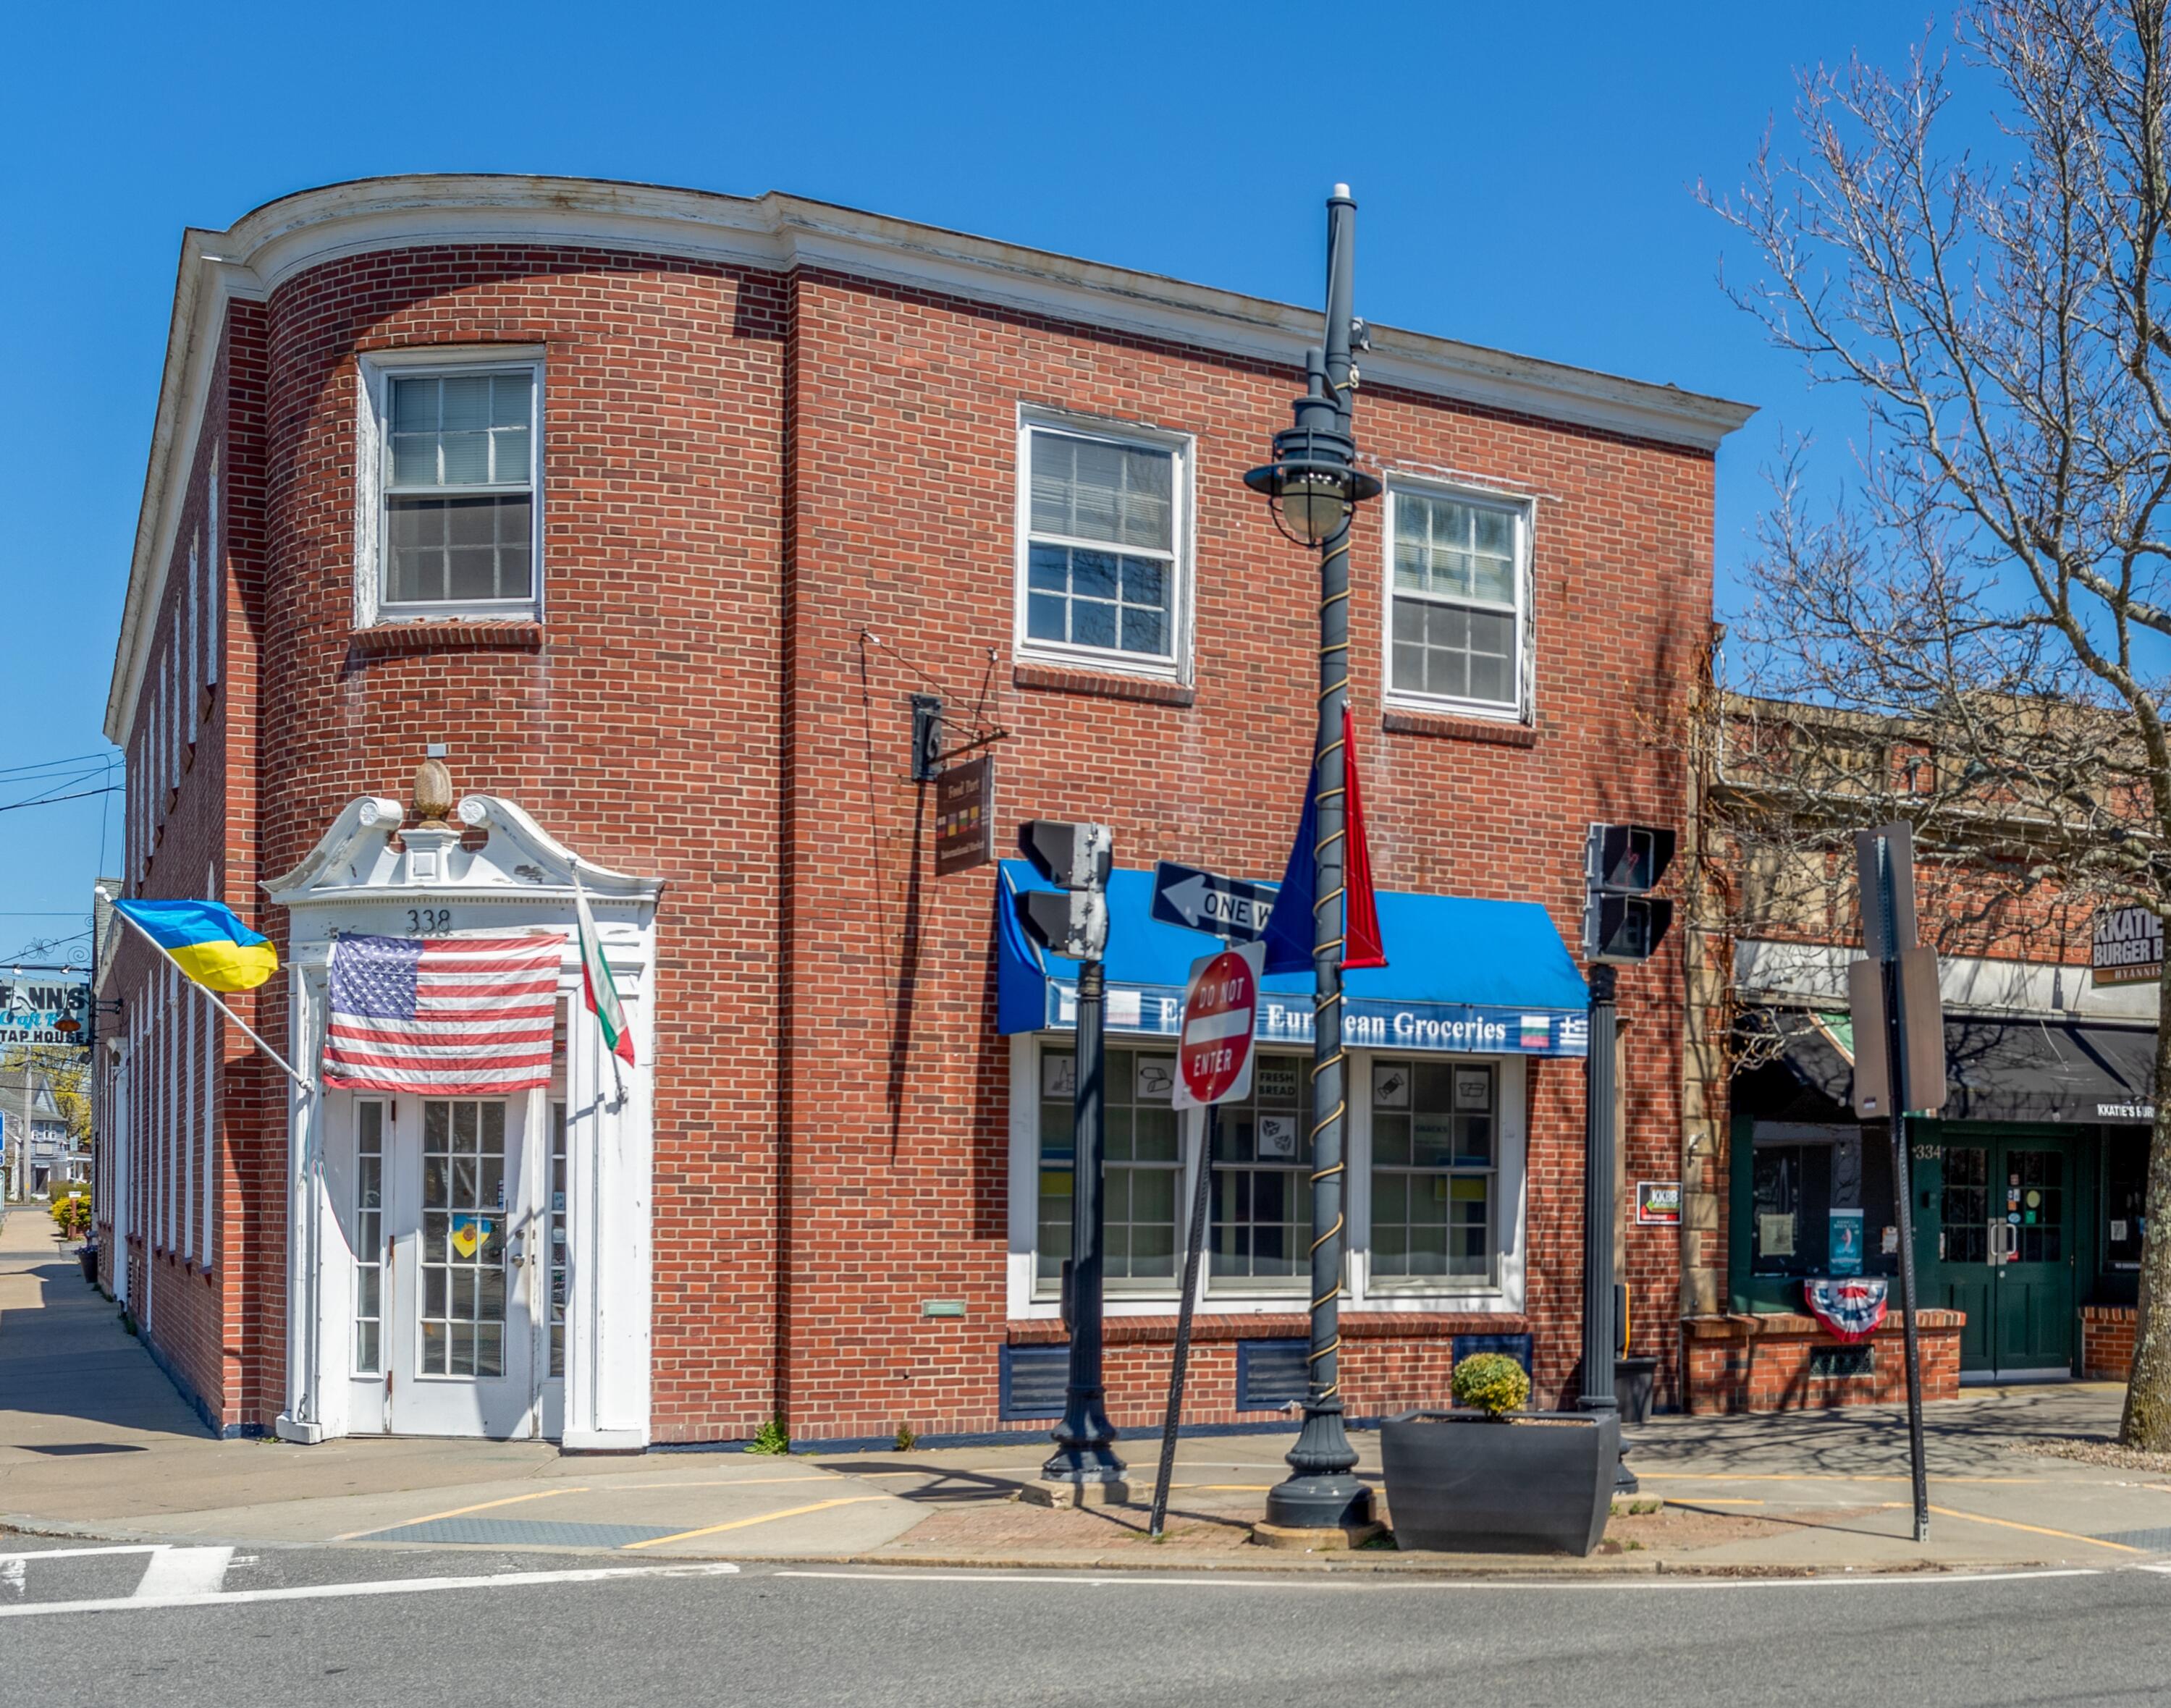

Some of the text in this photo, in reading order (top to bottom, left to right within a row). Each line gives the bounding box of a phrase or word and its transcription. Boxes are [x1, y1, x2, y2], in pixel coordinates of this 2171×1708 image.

[1205, 892, 1251, 924] ONE
[406, 909, 450, 932] 338
[2094, 939, 2151, 967] BURGER
[2115, 966, 2162, 979] HYANNIS
[1198, 977, 1245, 1009] DO NOT
[0, 1010, 41, 1030] Craft
[1267, 1004, 1506, 1039] Eurean Groceries
[0, 1030, 84, 1043] TAP HOUSE
[1194, 1048, 1232, 1077] ENTER
[1260, 1072, 1294, 1083] FRESH
[1259, 1085, 1296, 1095] BREAD
[2097, 1103, 2135, 1117] KKATIE'S
[1915, 1143, 1941, 1159] 334
